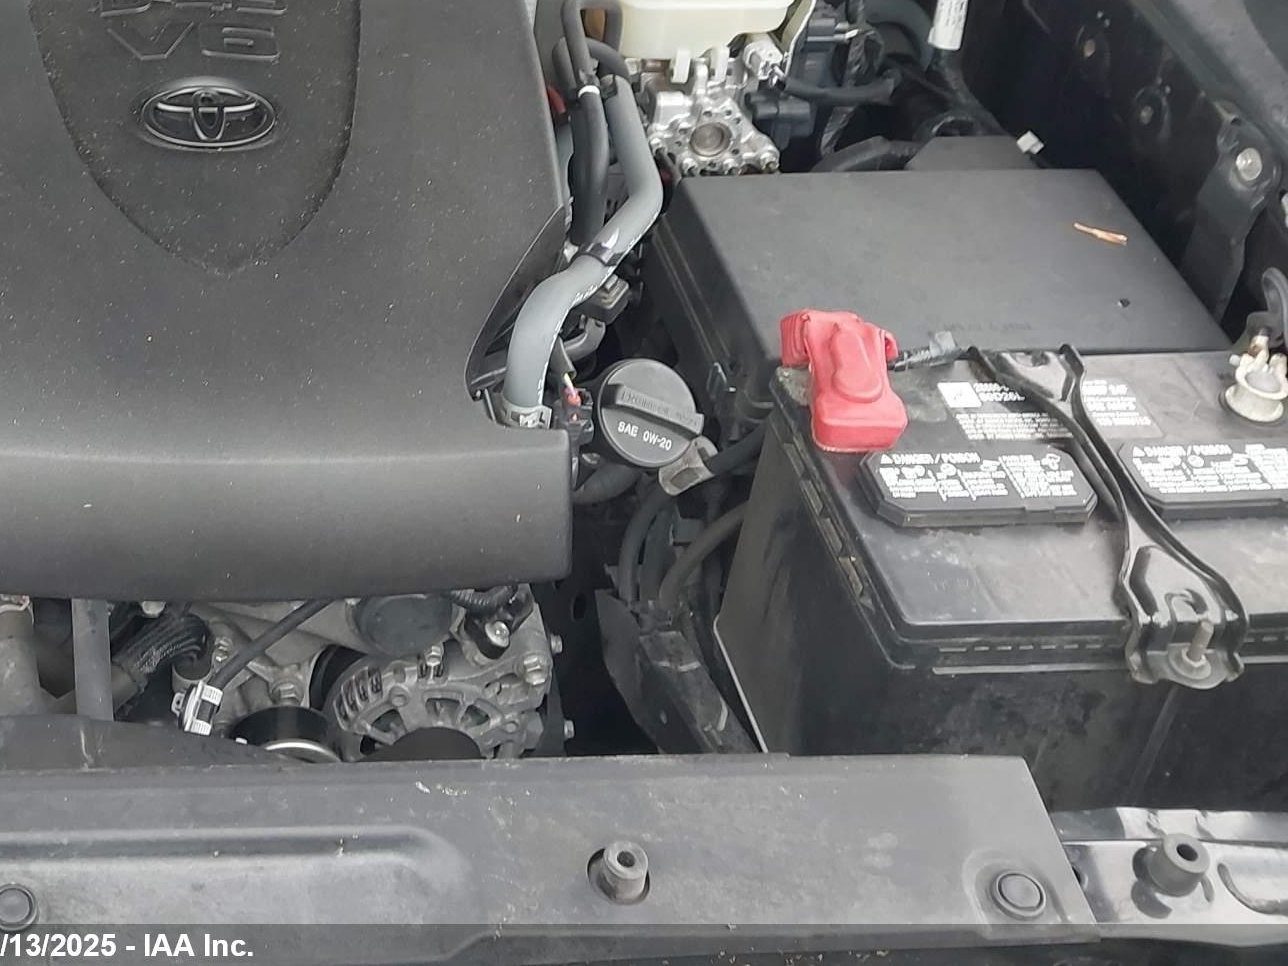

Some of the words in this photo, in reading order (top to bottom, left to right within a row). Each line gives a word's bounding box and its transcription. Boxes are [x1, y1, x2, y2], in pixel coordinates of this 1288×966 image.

[106, 20, 282, 62] V6
[618, 421, 639, 437] SAE
[643, 430, 672, 451] 0W-20
